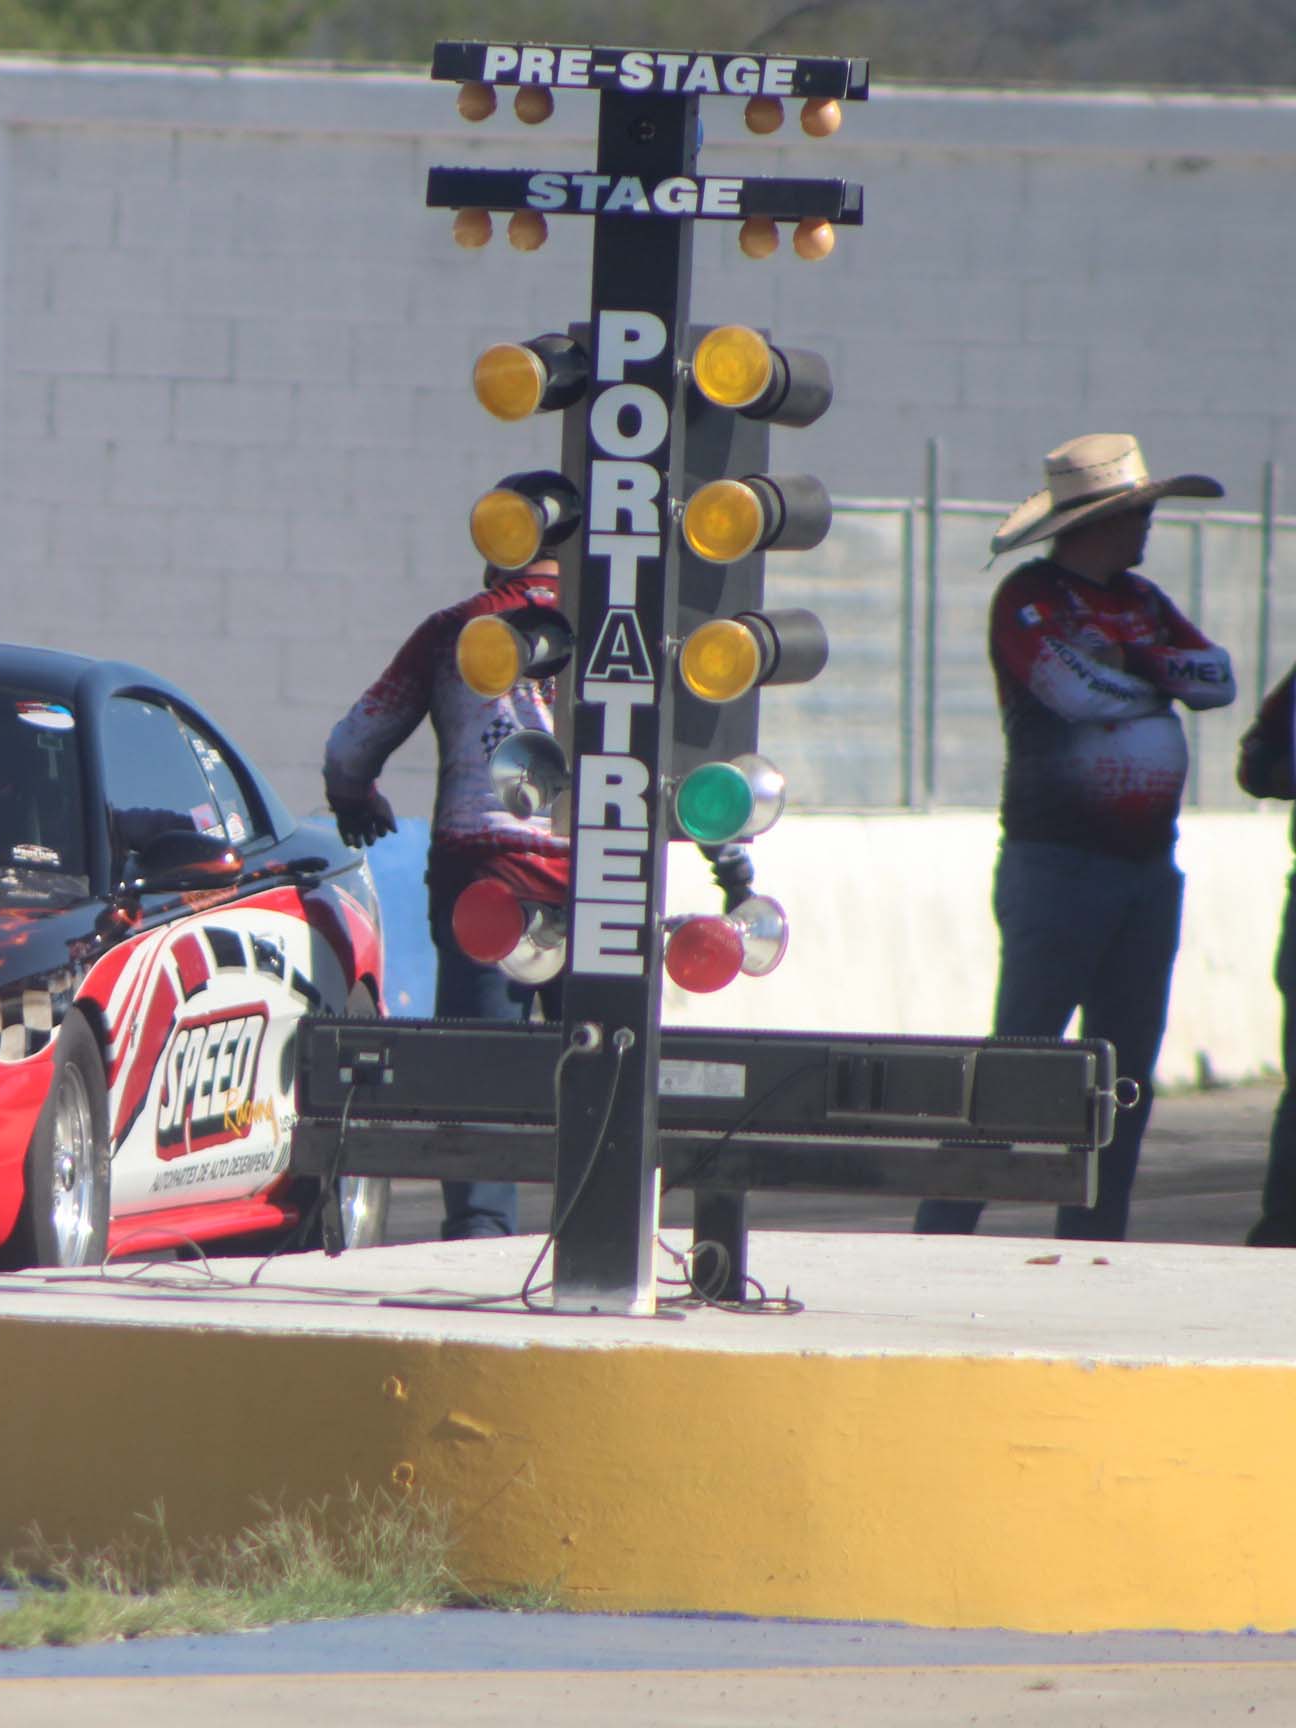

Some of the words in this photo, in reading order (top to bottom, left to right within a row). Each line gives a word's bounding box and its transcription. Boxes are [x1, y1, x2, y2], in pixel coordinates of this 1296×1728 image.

[483, 45, 797, 95] PRE-STAGE
[526, 173, 743, 215] STAGE
[571, 309, 669, 975] PORTATREE
[158, 1014, 265, 1130] SPEED
